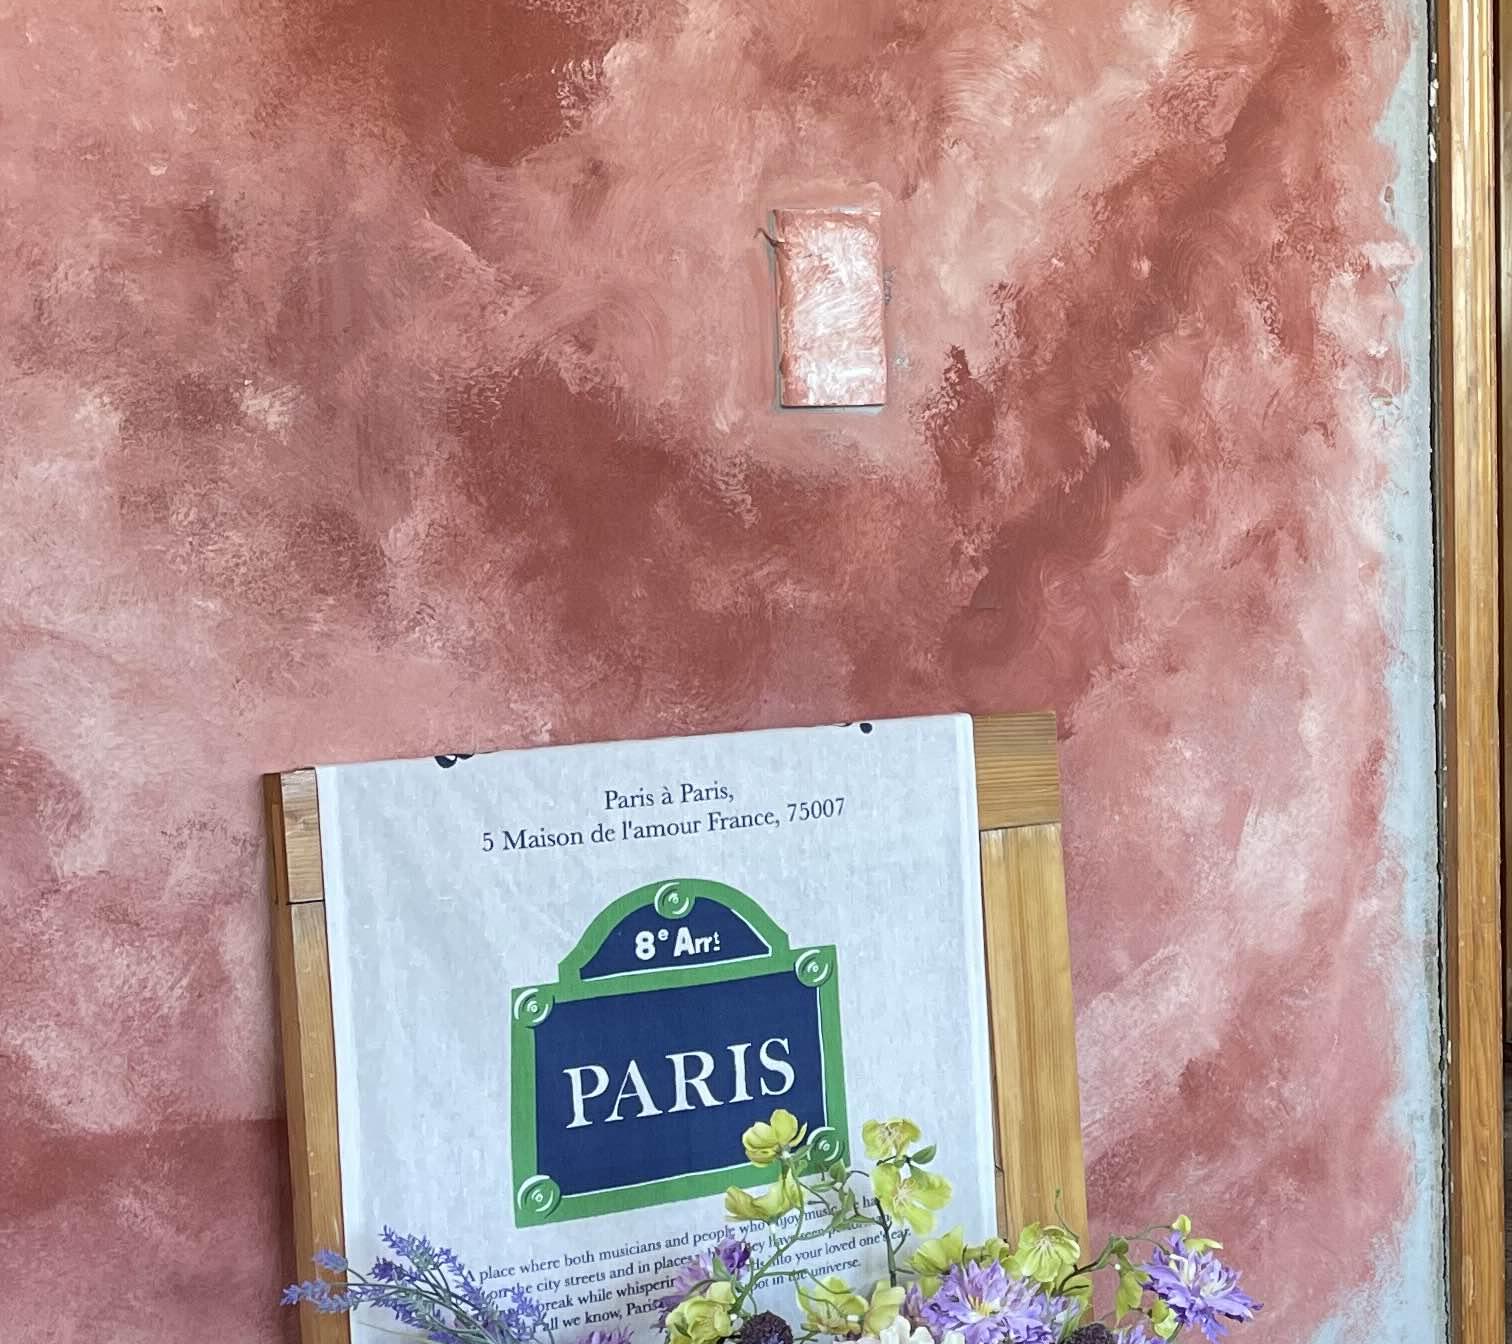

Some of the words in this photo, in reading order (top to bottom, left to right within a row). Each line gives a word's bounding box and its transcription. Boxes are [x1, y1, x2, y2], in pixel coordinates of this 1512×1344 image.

[482, 832, 495, 852] 5
[503, 825, 584, 851] Maison
[591, 822, 617, 843] de
[622, 819, 702, 841] l'amour
[707, 808, 781, 833] France,
[786, 797, 846, 823] 75007
[604, 786, 655, 810] Paris
[660, 785, 674, 805] à
[680, 780, 735, 804] Paris,
[563, 1037, 797, 1129] PARIS
[479, 1265, 516, 1285] place
[520, 1258, 561, 1274] where
[564, 1251, 596, 1267] both
[599, 1241, 662, 1262] musicians
[666, 1233, 689, 1248] and
[738, 1220, 765, 1235] who
[536, 1278, 561, 1294] city
[564, 1272, 607, 1287] streets
[609, 1264, 634, 1279] and
[638, 1262, 651, 1274] in
[578, 1289, 613, 1306] while
[794, 1249, 822, 1264] your
[824, 1240, 857, 1255] loved
[563, 1317, 581, 1328] we
[584, 1308, 622, 1326] know,
[772, 1274, 785, 1284] in
[811, 1259, 861, 1277] universe.
